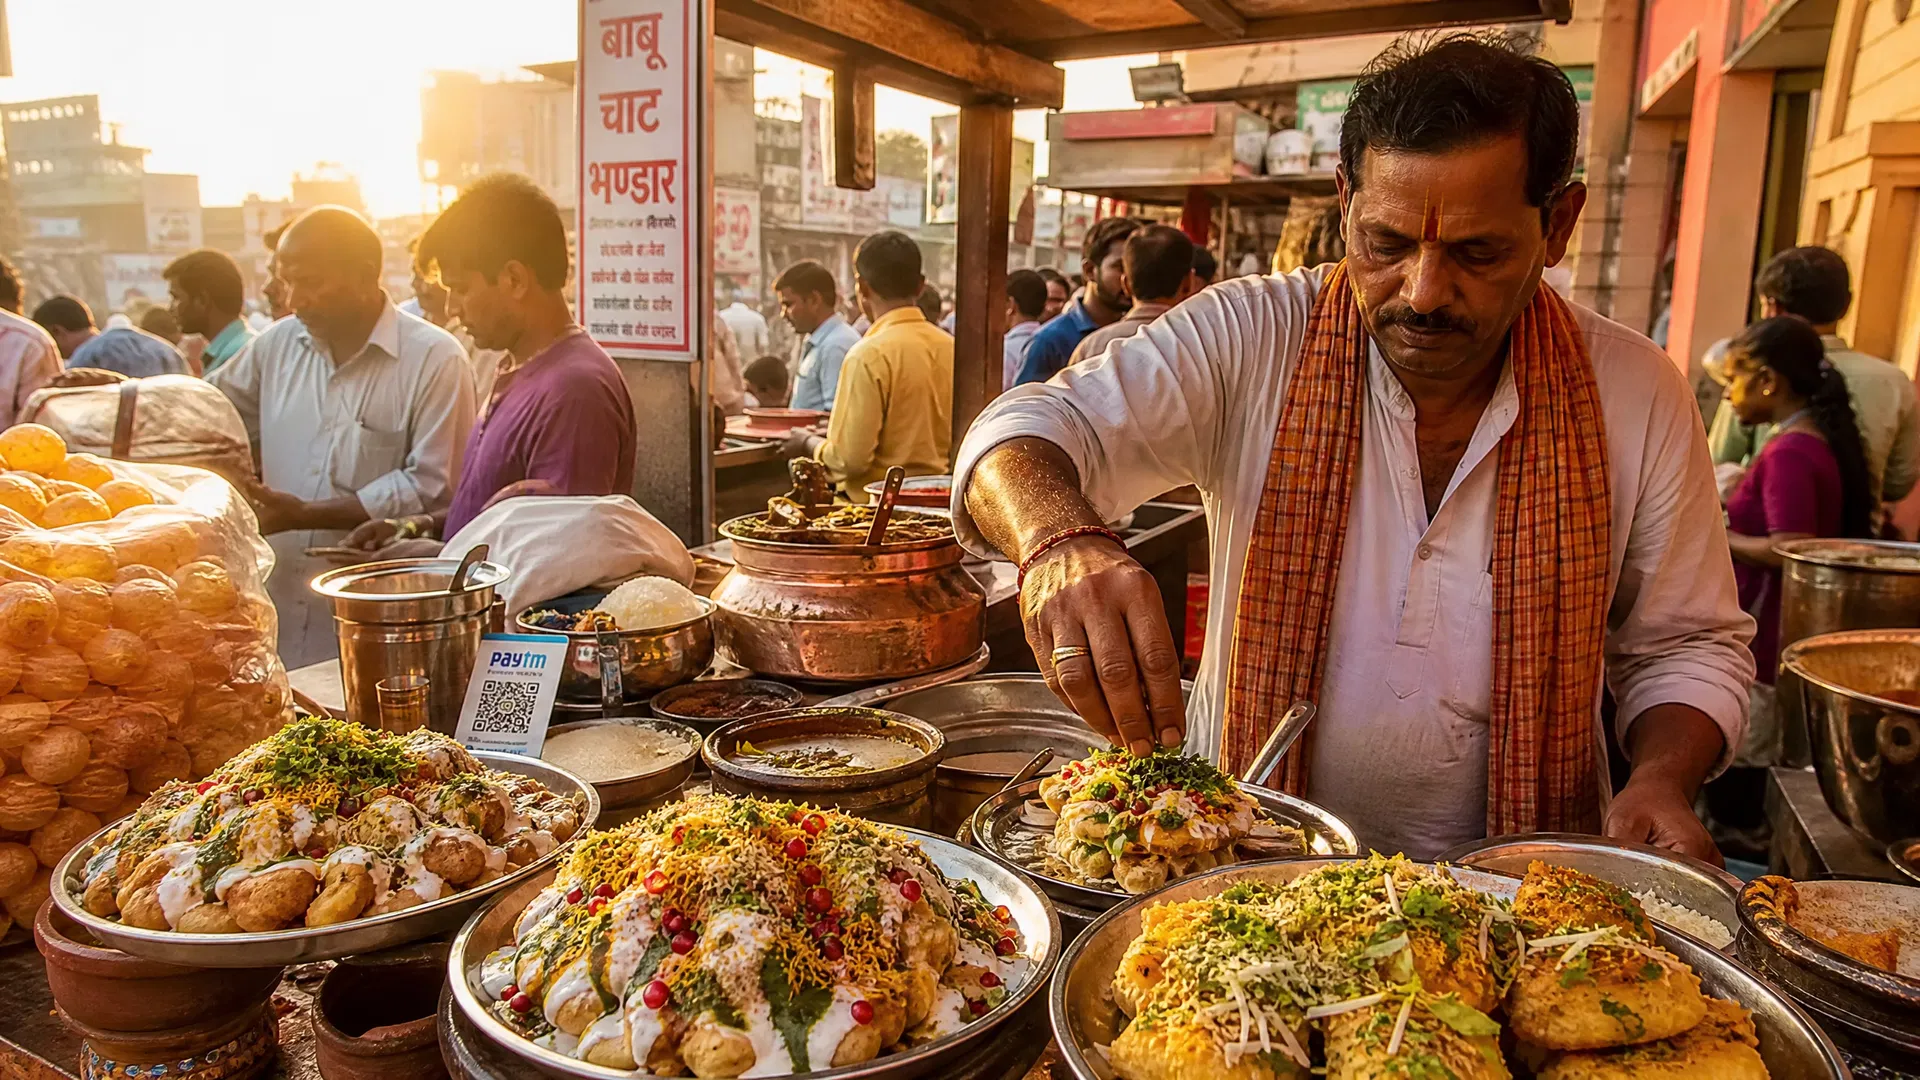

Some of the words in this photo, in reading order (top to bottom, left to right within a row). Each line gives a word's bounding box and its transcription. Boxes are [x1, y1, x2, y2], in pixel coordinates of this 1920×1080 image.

[600, 13, 667, 70] बाबू
[599, 88, 663, 135] चाट
[589, 159, 678, 205] भण्डार
